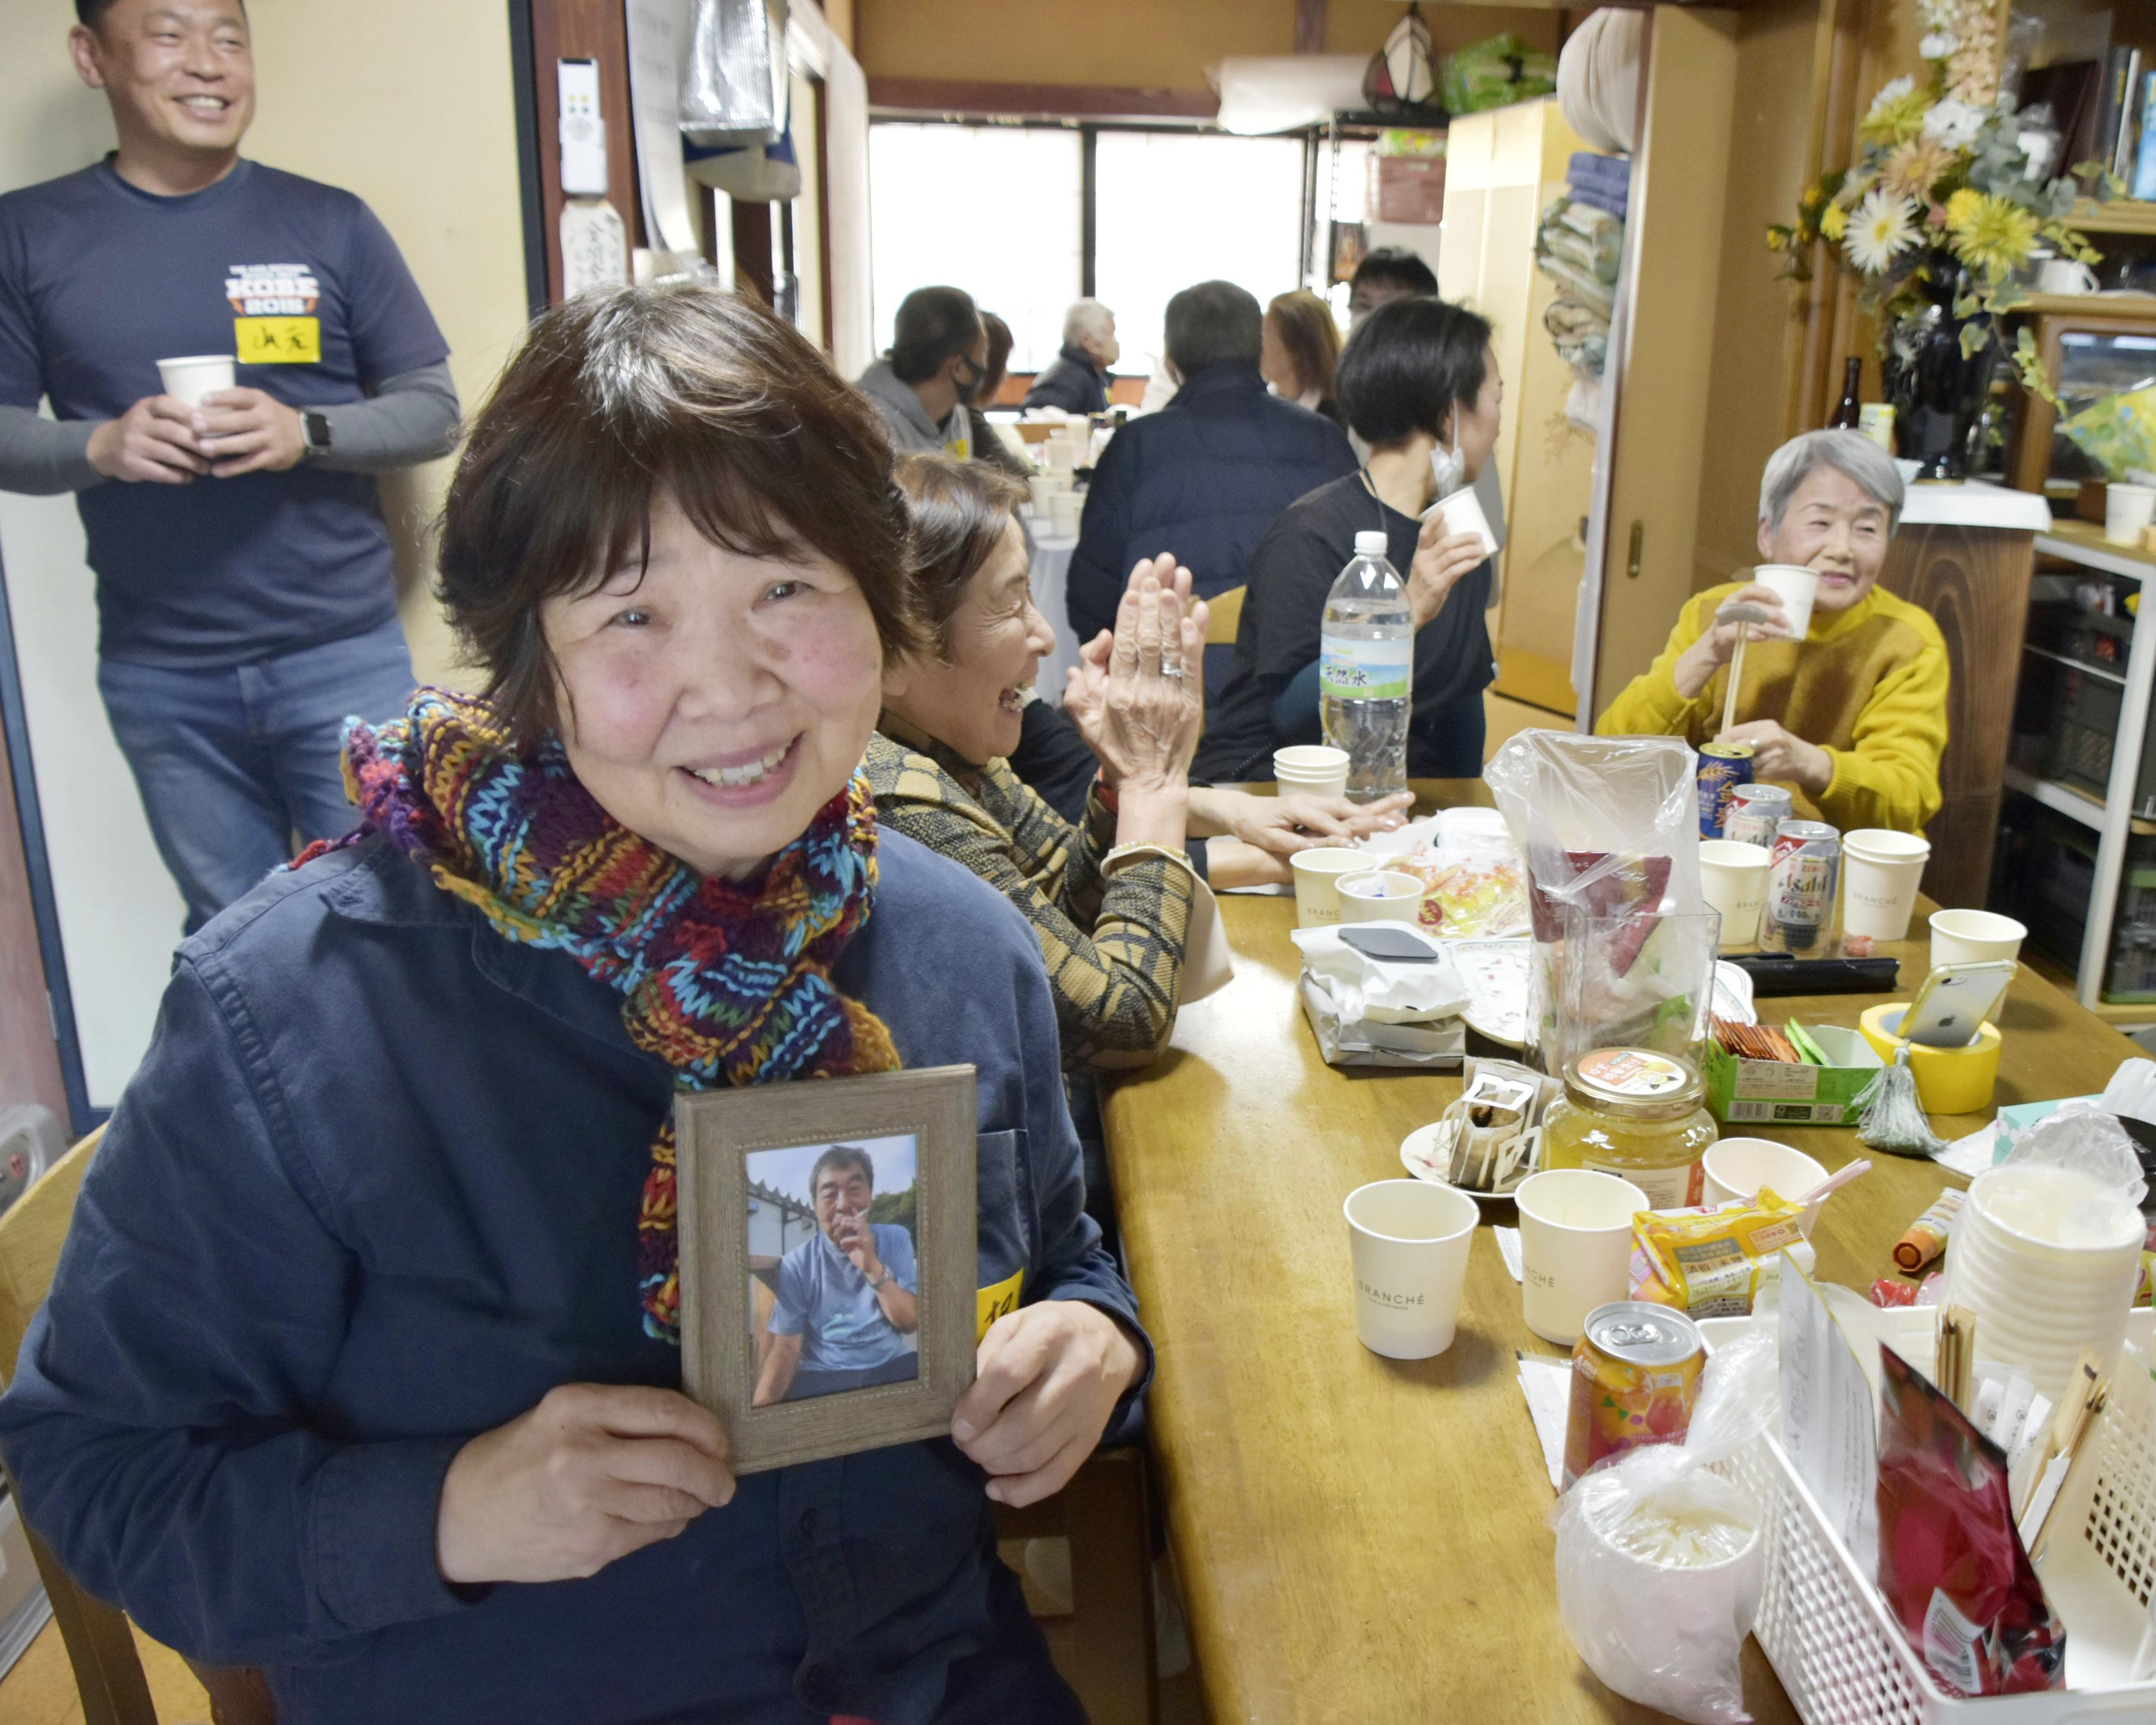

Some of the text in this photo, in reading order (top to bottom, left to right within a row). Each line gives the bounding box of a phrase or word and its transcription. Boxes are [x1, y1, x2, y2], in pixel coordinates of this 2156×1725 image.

[1326, 666, 1368, 686] 天然水
[1778, 873, 1828, 893] Asahi
[1308, 906, 1341, 917] BRANC
[1358, 1280, 1424, 1305] BRANCHÉ
